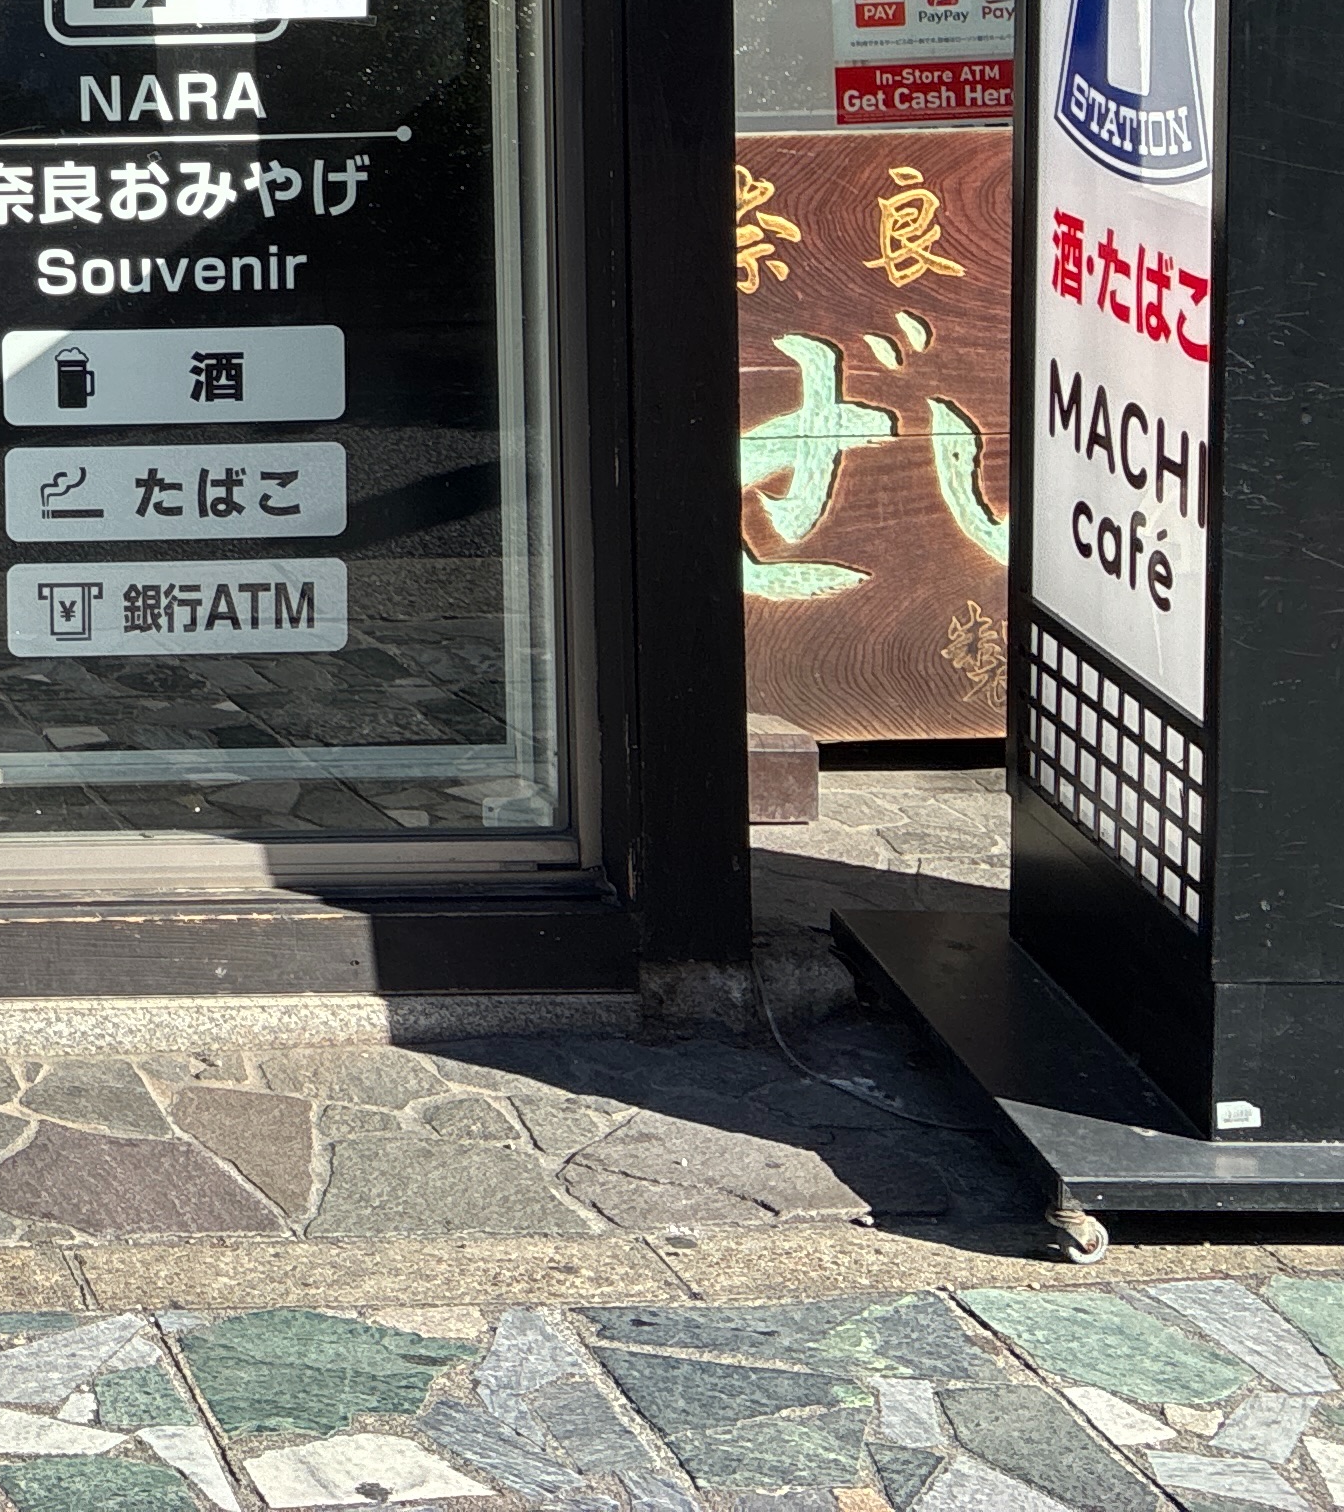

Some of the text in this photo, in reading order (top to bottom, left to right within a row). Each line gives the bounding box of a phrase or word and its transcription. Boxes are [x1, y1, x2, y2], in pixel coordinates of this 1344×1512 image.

[864, 4, 897, 20] PAY
[918, 9, 969, 24] PayPay
[982, 6, 1015, 21] Pay
[79, 72, 267, 122] NARA
[843, 90, 887, 113] Get
[894, 86, 956, 110] Cash
[875, 64, 1000, 85] In-Store ATM
[1070, 73, 1193, 156] STATION
[37, 245, 307, 296] Souvenir
[189, 350, 245, 403] 酒
[1049, 357, 1208, 529] MACHI
[134, 467, 302, 518] たばこ
[1072, 500, 1173, 613] café
[122, 580, 316, 634] 銀行ATM
